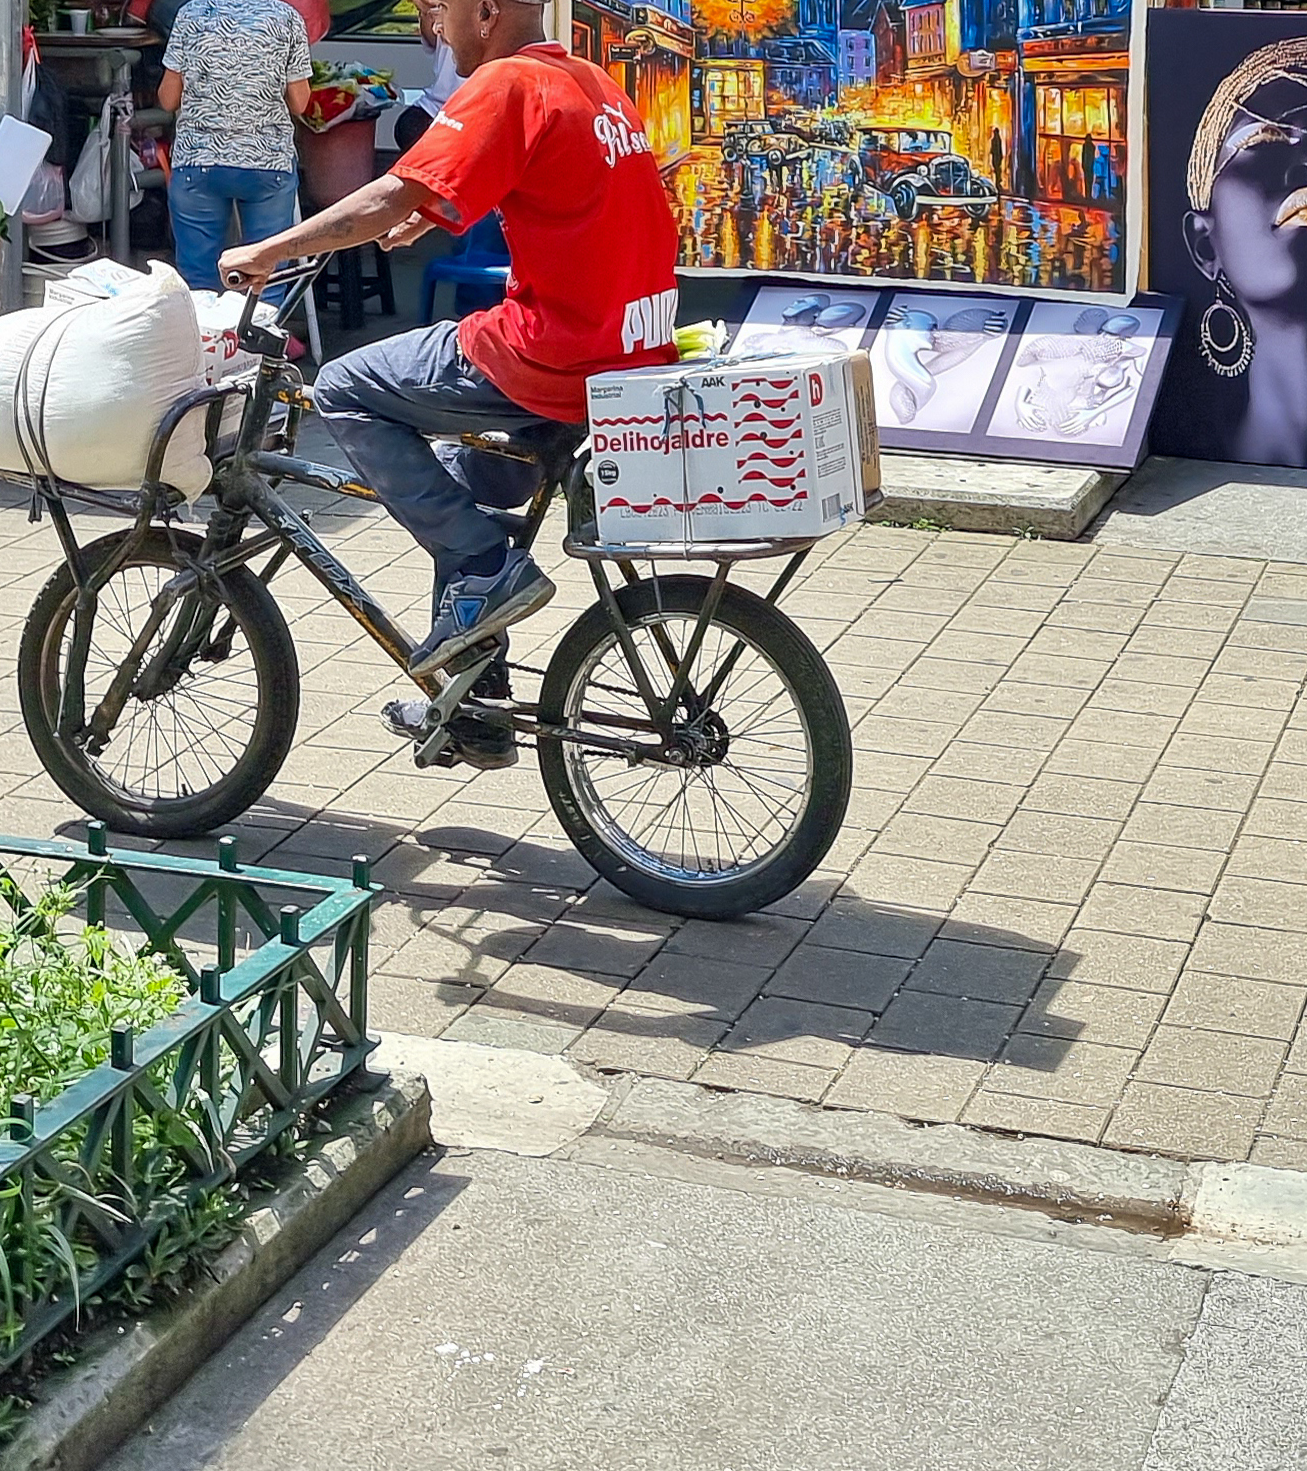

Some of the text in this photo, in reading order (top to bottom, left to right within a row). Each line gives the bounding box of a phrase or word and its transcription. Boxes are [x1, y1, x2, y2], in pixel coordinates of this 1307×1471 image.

[700, 376, 726, 388] AAK
[590, 385, 624, 394] Margarina
[591, 392, 622, 400] Industrial
[593, 428, 729, 455] Delihojaldre
